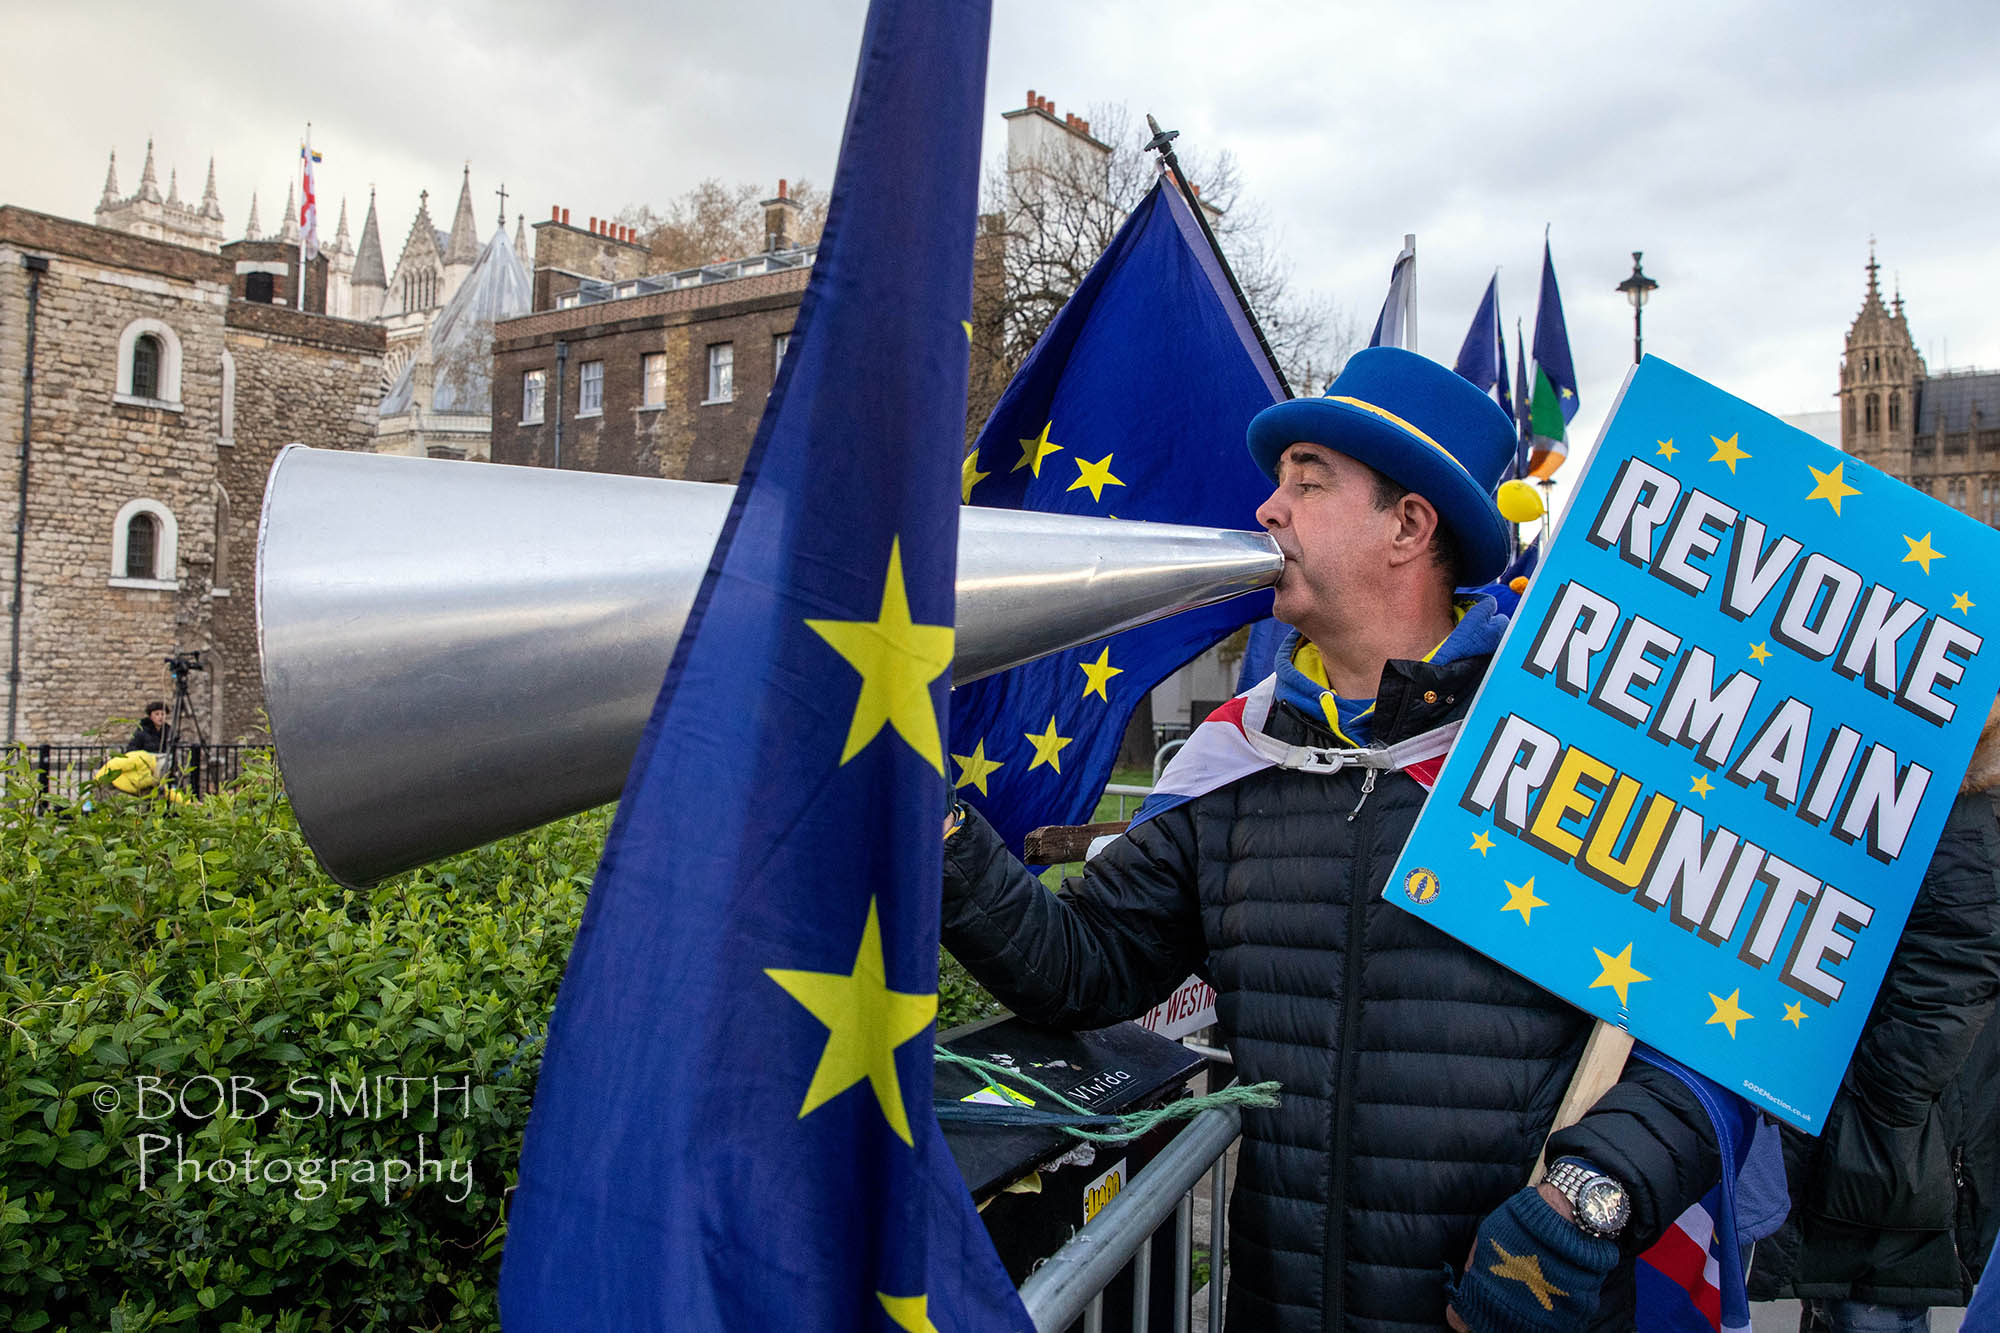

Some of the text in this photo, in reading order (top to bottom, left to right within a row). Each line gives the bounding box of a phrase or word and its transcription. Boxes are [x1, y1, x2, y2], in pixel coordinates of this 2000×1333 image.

[1521, 579, 1932, 865] REMAIN
[1587, 456, 1983, 728] REVOKE
[1458, 712, 1874, 1007] REUNITE
[1068, 1070, 1131, 1101] Vivida
[1743, 1079, 1812, 1122] SODEMaction.co.uk
